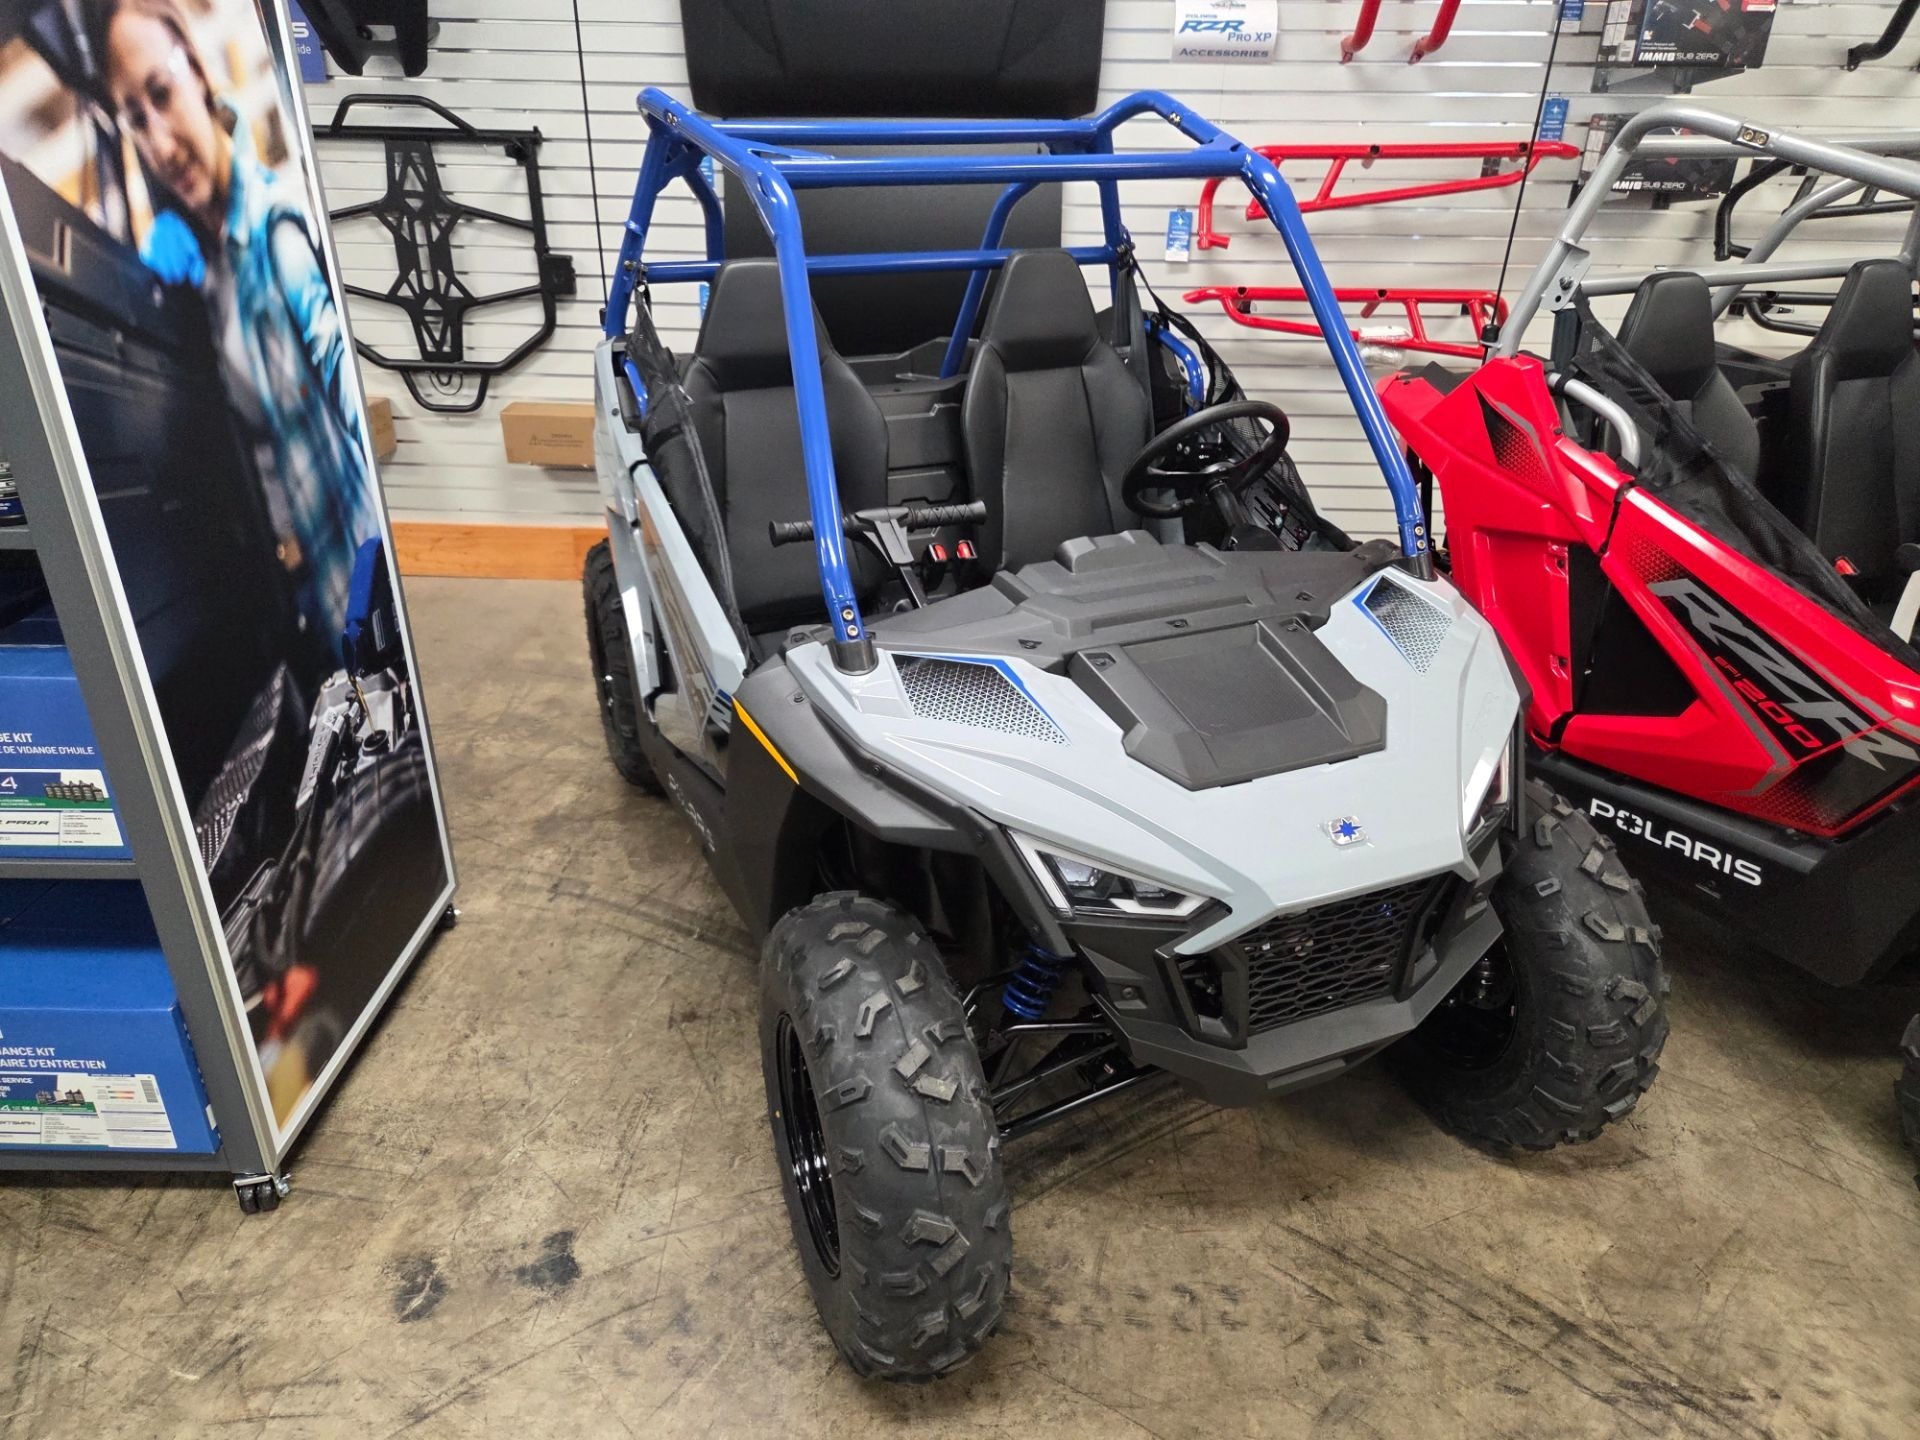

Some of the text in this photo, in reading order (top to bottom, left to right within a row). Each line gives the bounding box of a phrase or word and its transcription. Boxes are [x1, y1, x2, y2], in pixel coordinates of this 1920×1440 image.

[1179, 20, 1245, 33] RZR
[1254, 32, 1272, 42] XP
[1676, 52, 1694, 60] SUB
[1647, 578, 1920, 771] RZR
[1734, 678, 1823, 748] 200
[13, 733, 32, 743] KIT
[3, 746, 95, 755] DE VIDANGE D'HUILE
[1589, 798, 1762, 886] POLARIS
[36, 1047, 56, 1057] KIT
[29, 1060, 107, 1070] D'ENTRETIEN
